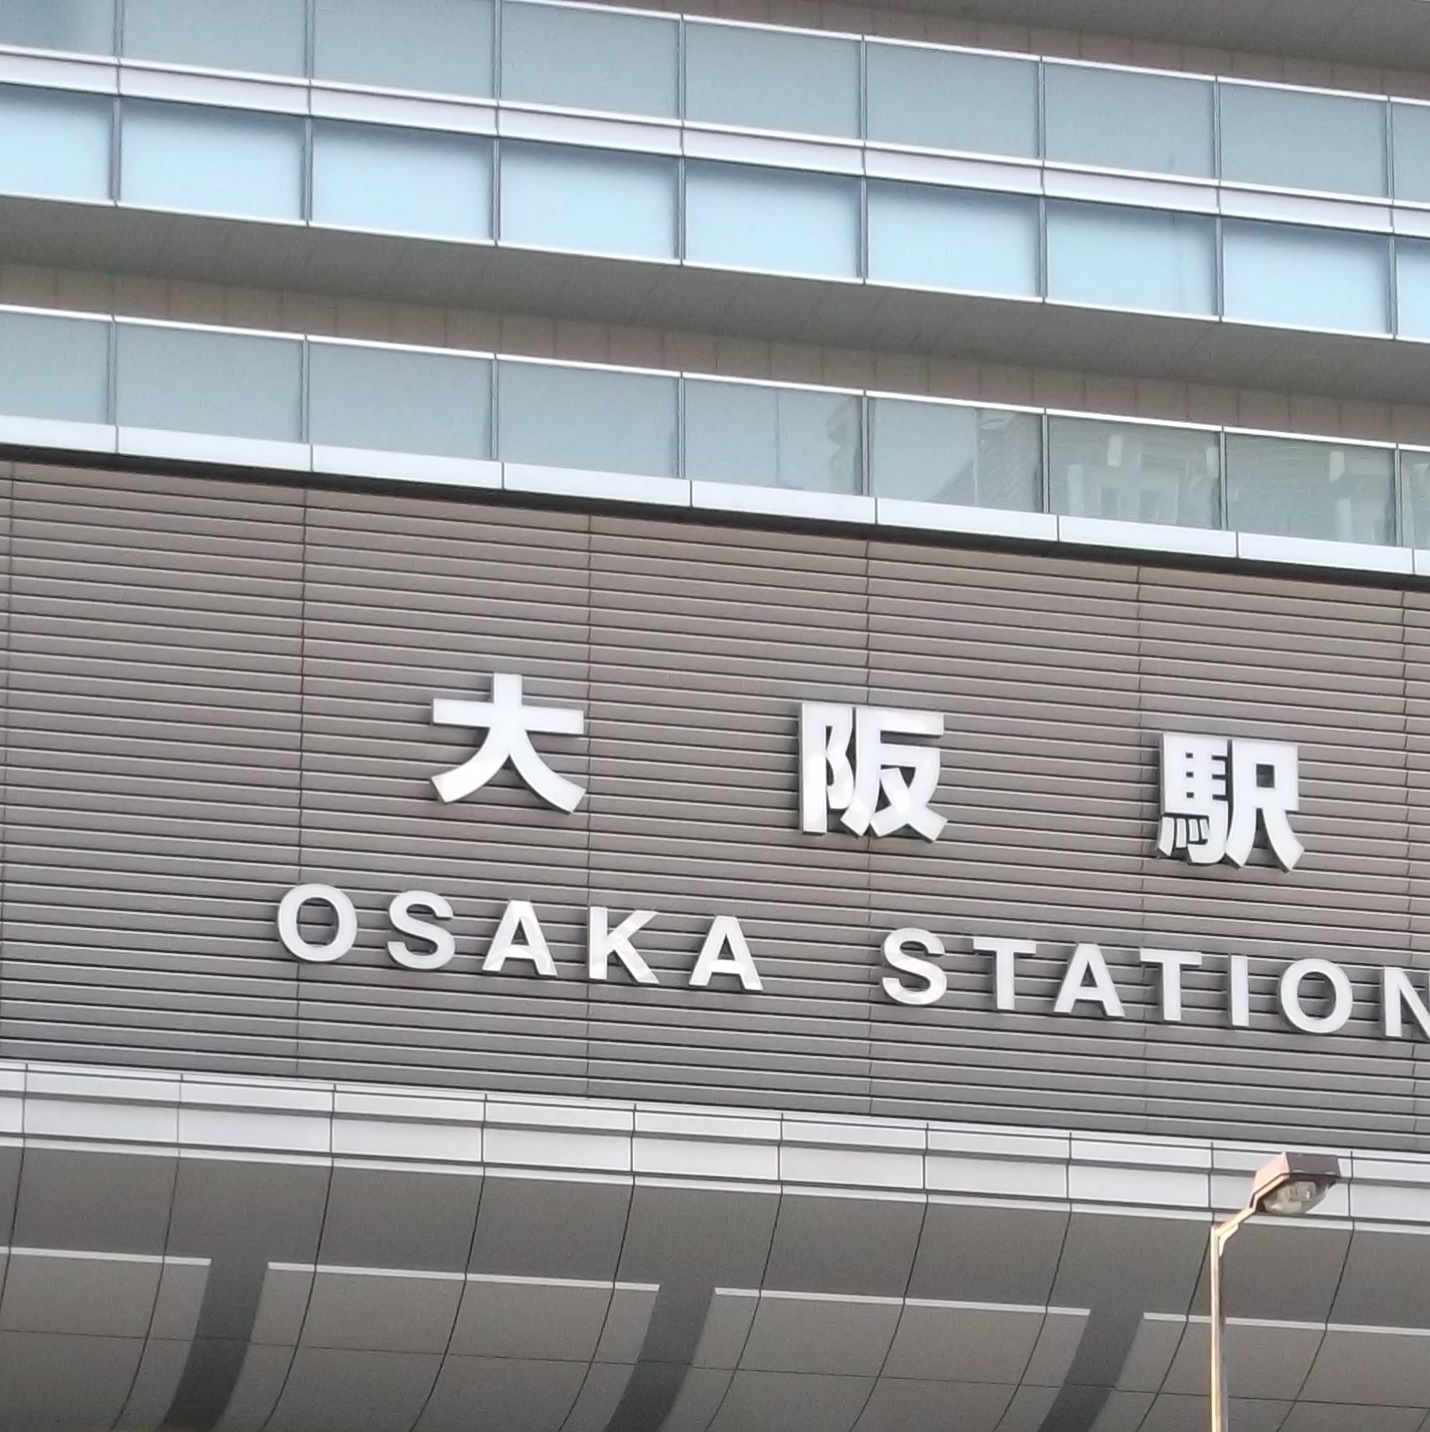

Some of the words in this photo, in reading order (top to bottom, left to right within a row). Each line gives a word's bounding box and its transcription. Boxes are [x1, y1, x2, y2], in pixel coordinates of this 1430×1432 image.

[431, 673, 1305, 872] 大阪駅
[276, 882, 764, 992] OSAKA
